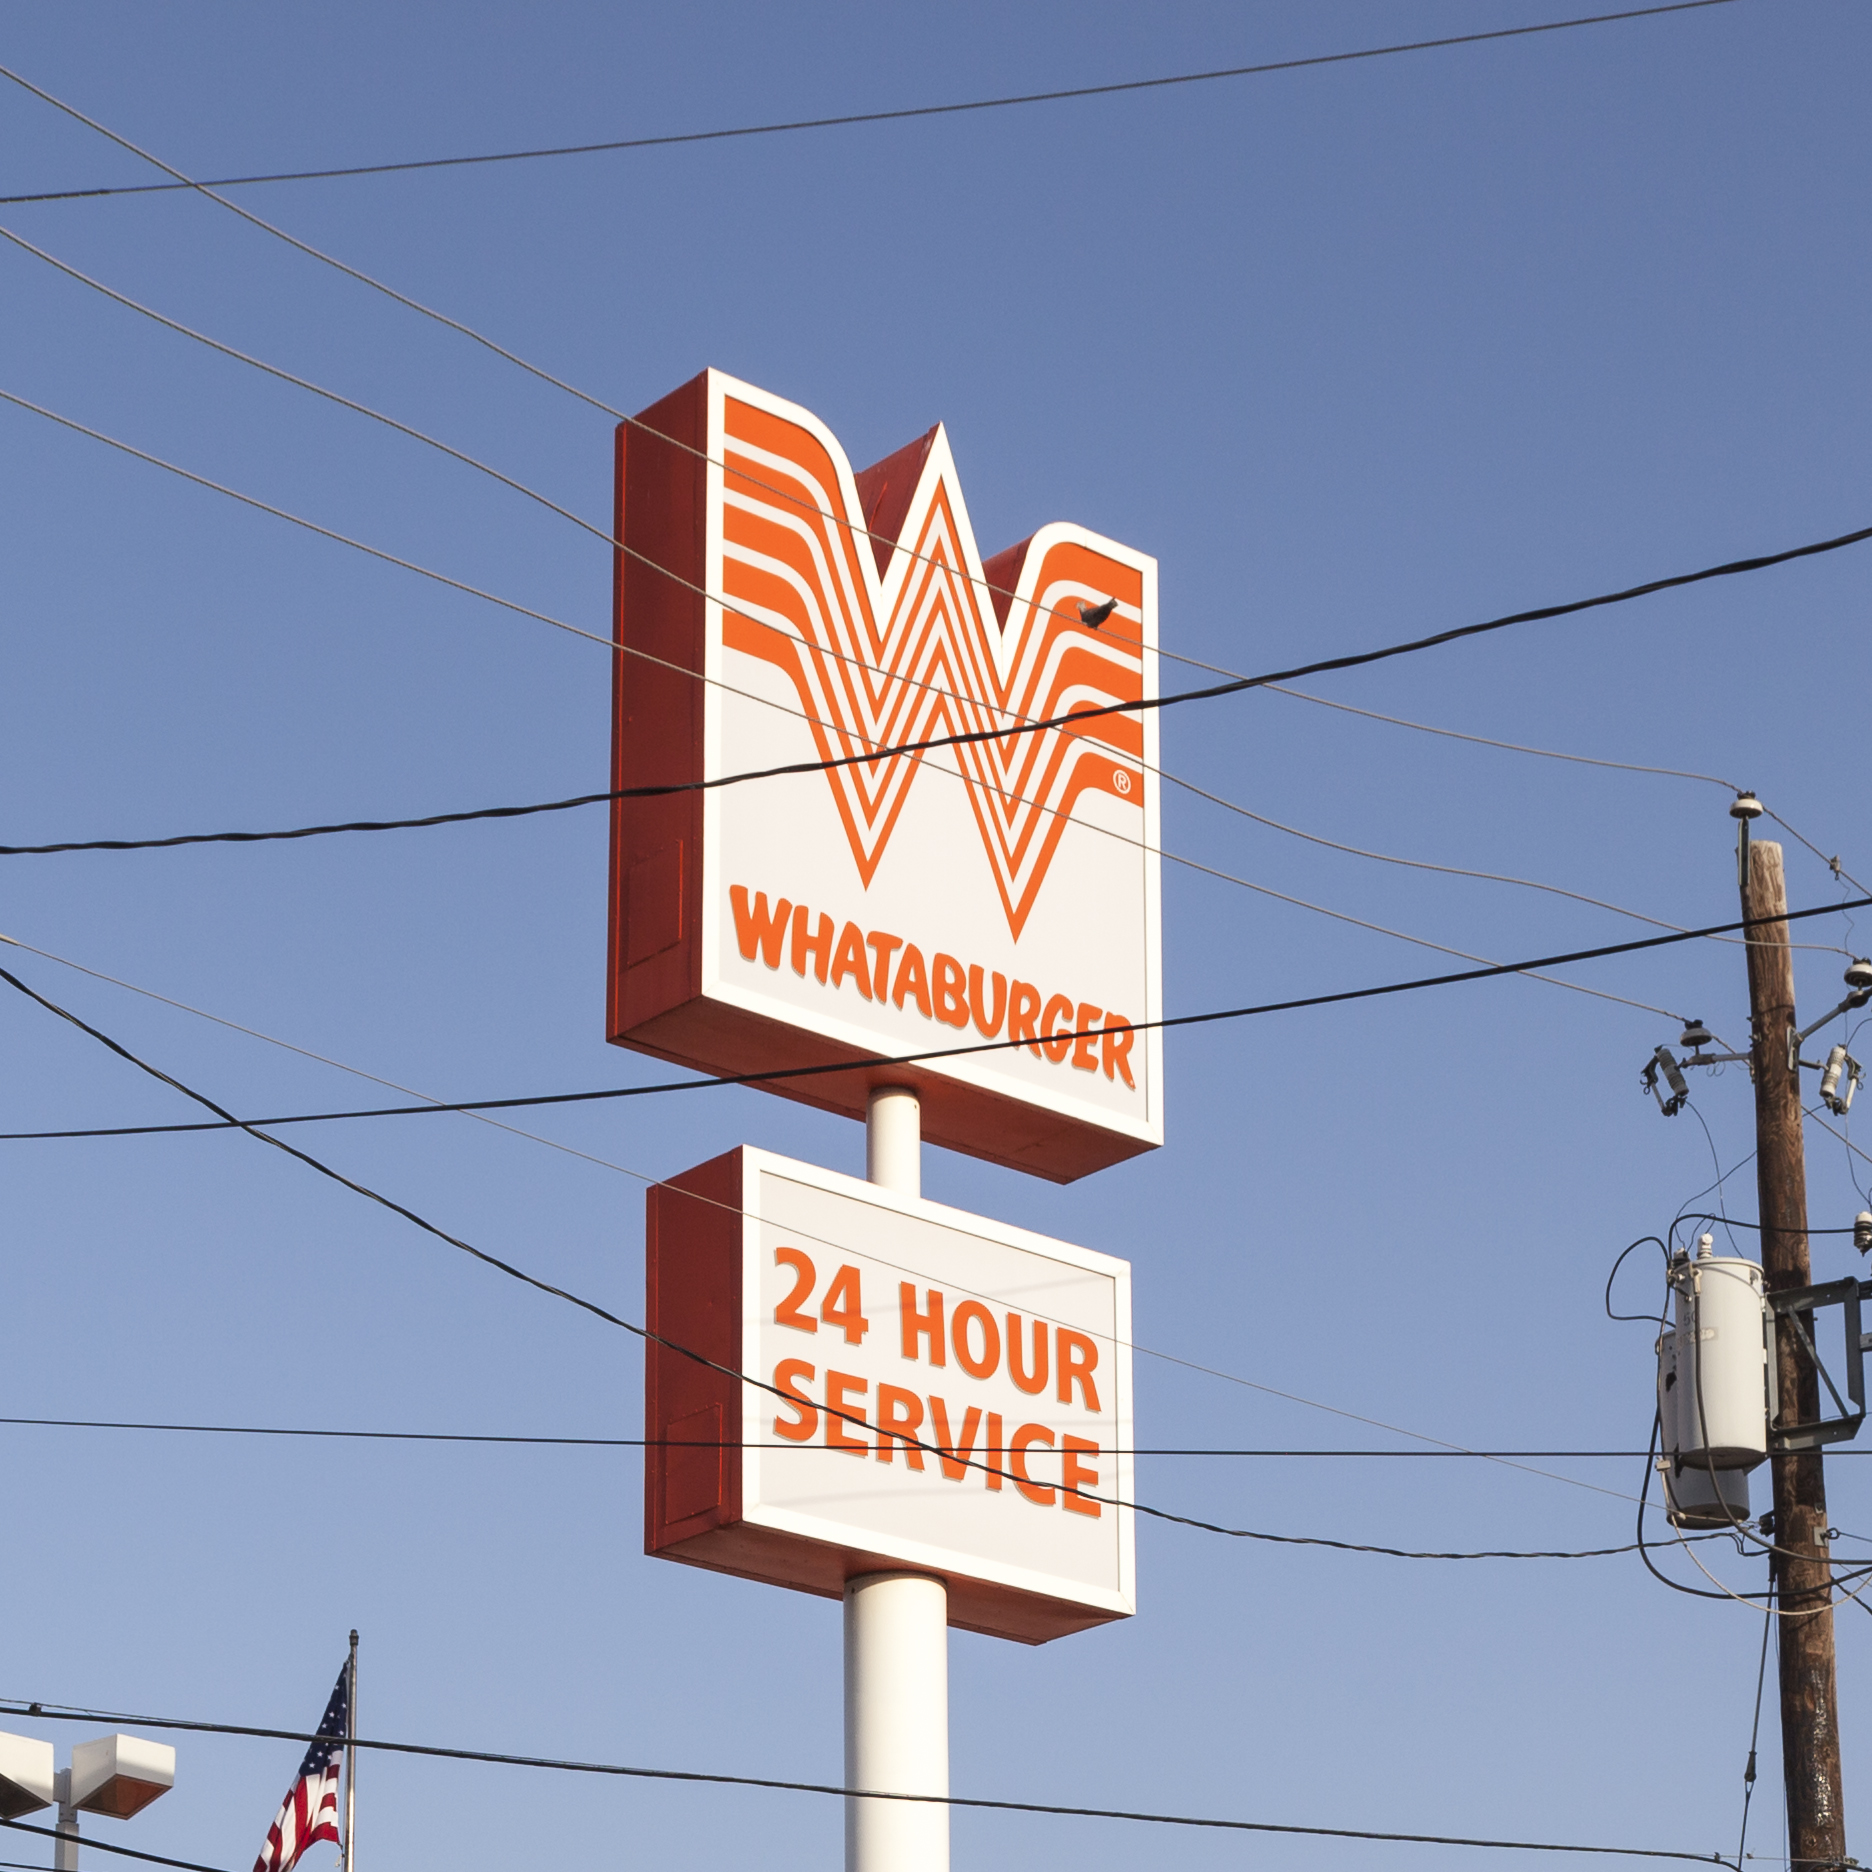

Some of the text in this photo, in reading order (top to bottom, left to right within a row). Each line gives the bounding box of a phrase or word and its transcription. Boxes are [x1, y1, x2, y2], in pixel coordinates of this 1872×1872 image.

[728, 883, 1137, 1092] WHATABURGER
[774, 1246, 1103, 1413] 24 HOUR
[772, 1357, 1102, 1519] SERVICE
